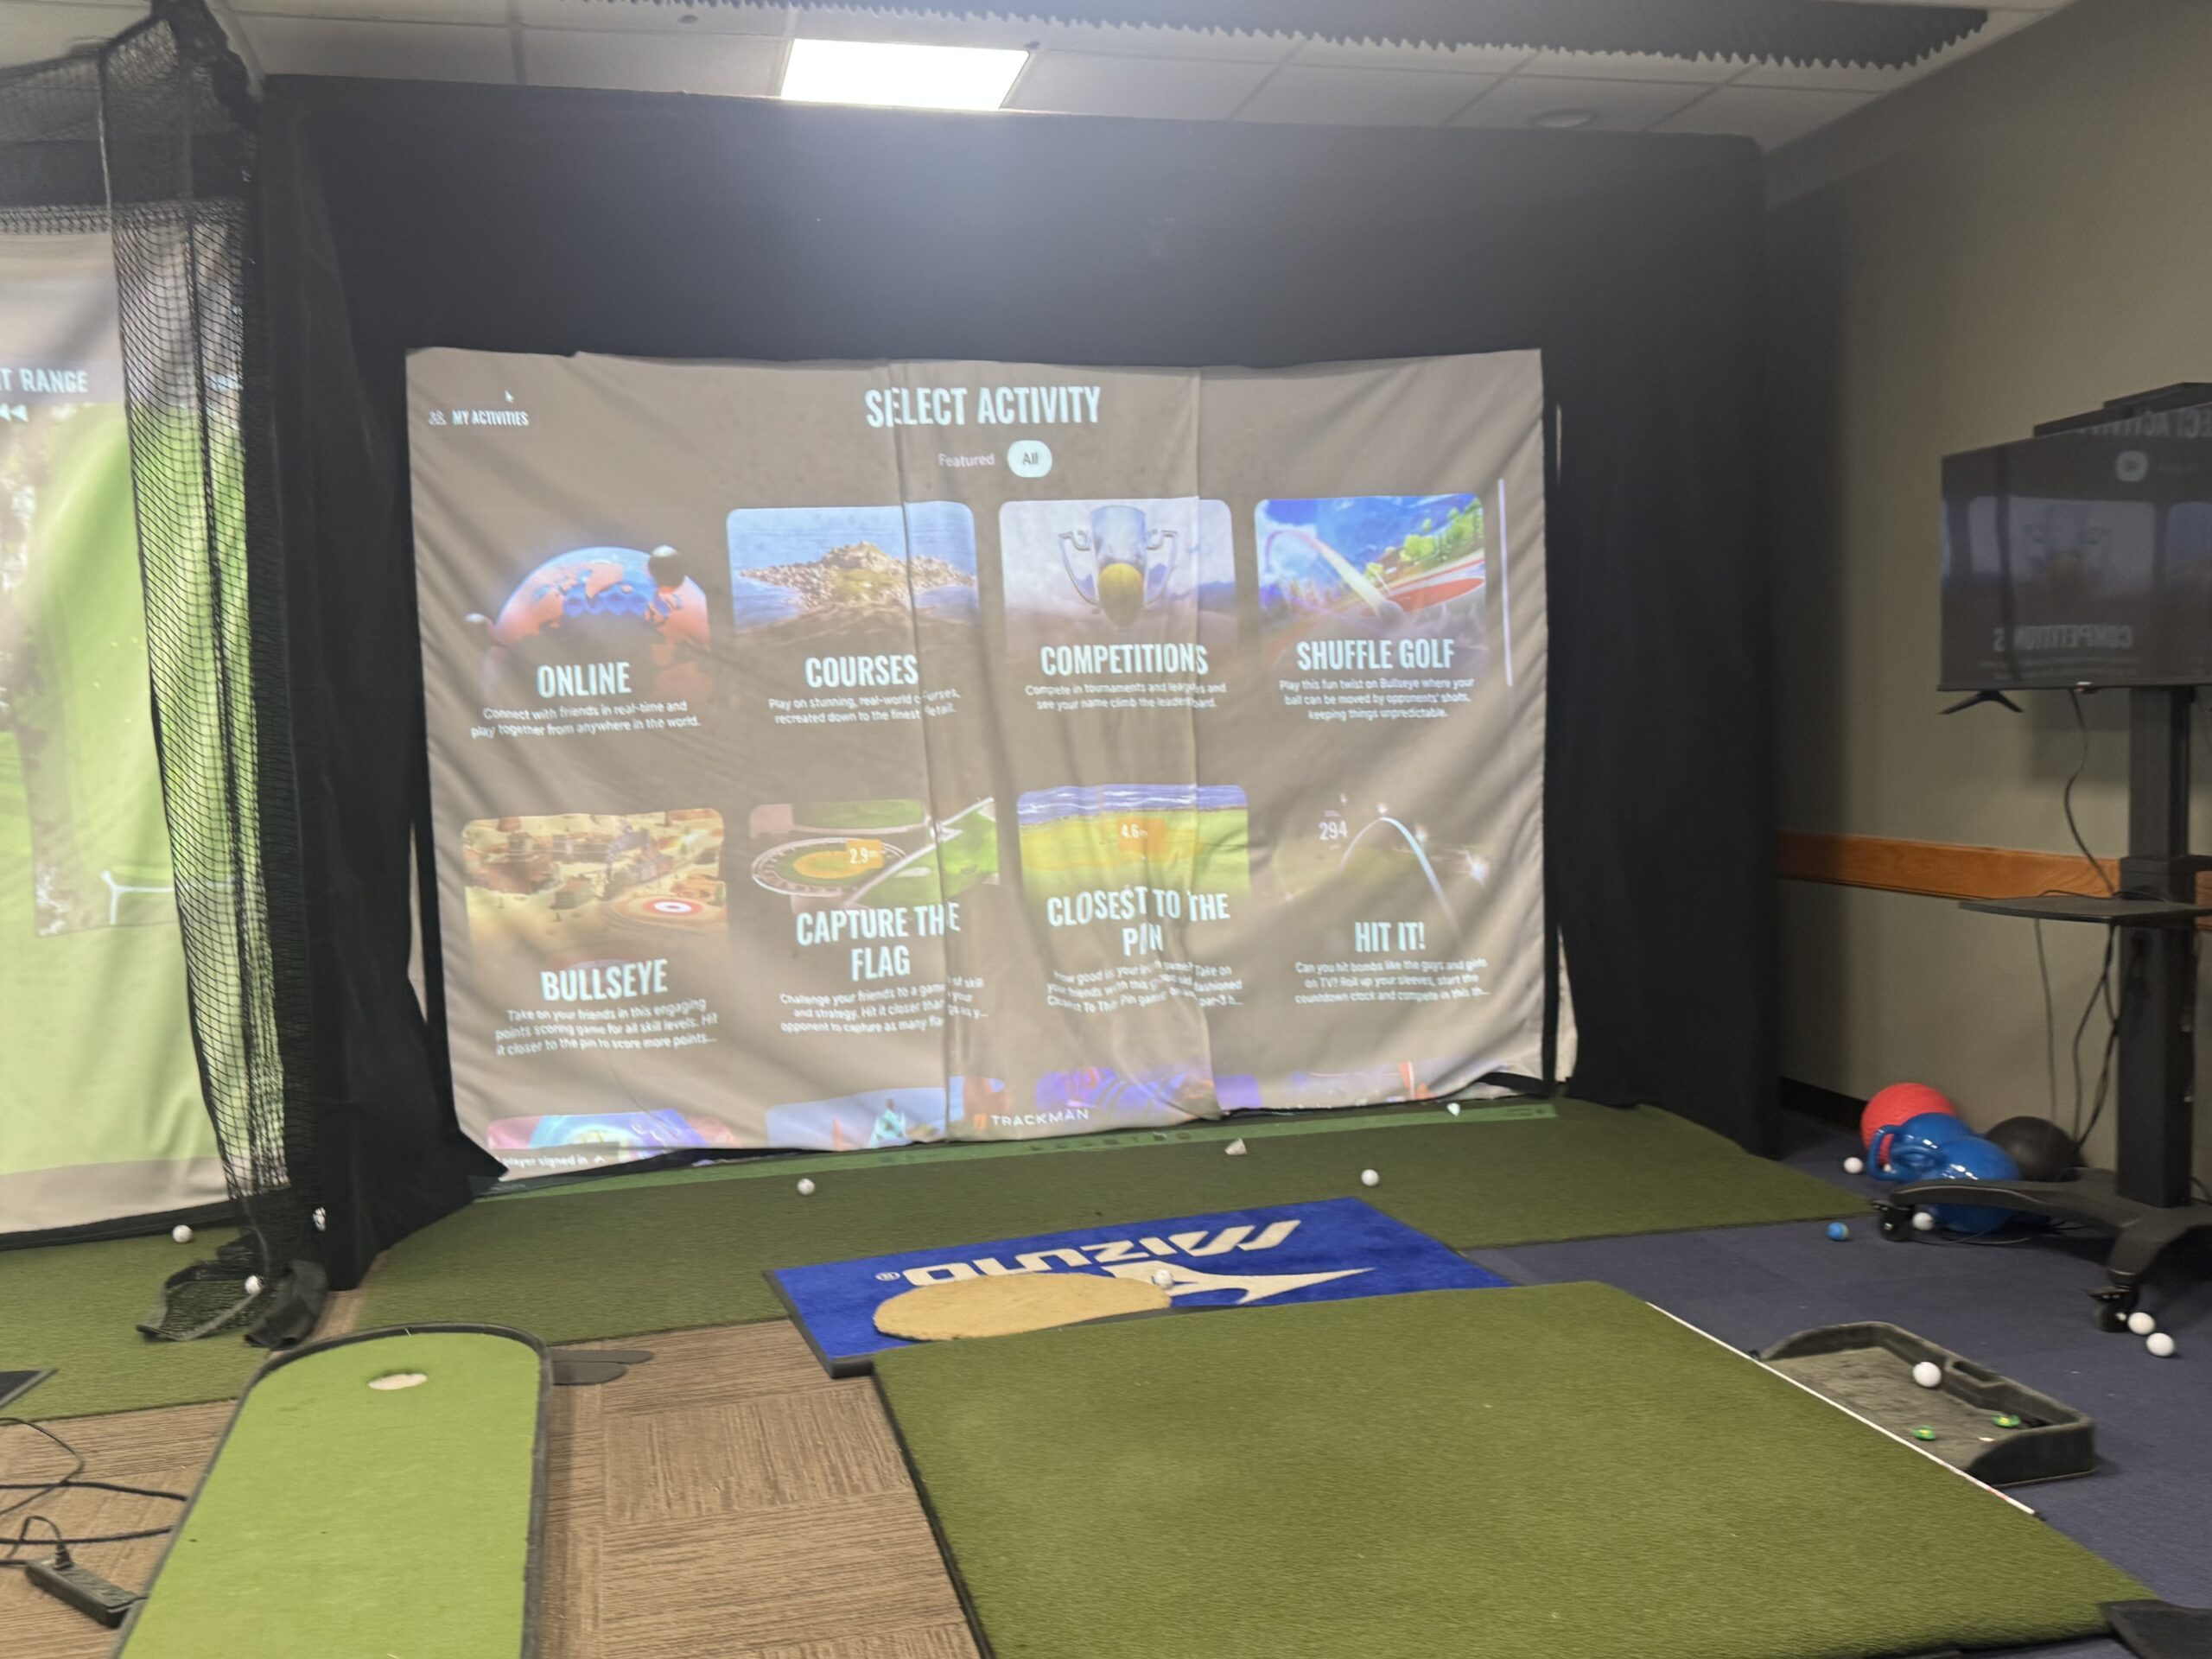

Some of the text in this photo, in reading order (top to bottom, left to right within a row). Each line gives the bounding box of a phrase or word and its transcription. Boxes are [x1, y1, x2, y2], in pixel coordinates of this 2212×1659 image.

[19, 367, 88, 393] RANGE
[452, 410, 529, 426] MY ACTIVITIES
[864, 385, 1101, 428] SELECT ACTIVITY
[938, 453, 995, 468] Featured
[1021, 452, 1039, 465] All
[1040, 643, 1209, 676] COMPETITIONS
[1296, 639, 1454, 671] SHUFFLE GOLF
[537, 661, 632, 698] ONLINE
[805, 654, 918, 688] COURSES
[1279, 678, 1475, 692] Play this fun twist on Bullseye where your
[482, 701, 688, 721] Connect with friends in real-time and
[768, 698, 791, 711] Play
[793, 699, 807, 709] on
[810, 696, 858, 709] stunning,
[859, 694, 912, 707] real-world
[470, 715, 702, 739] play together from anywhere in the world.
[774, 709, 921, 724] recreated down to the finest
[1318, 820, 1348, 840] 294
[1046, 886, 1230, 927] CLOSEST TO THE
[796, 901, 961, 946] CAPTURE THE
[1355, 921, 1426, 952] HIT IT!
[1122, 922, 1163, 957] PIN
[850, 945, 911, 982] FLAG
[540, 958, 668, 1002] BULLSEYE
[505, 998, 707, 1021] Take on your friends in this engaging
[494, 1011, 718, 1041] points scoring game for all skill levels. Hit
[506, 1038, 671, 1056] closer to the pin to score more
[990, 1109, 1089, 1127] TRACKMAN
